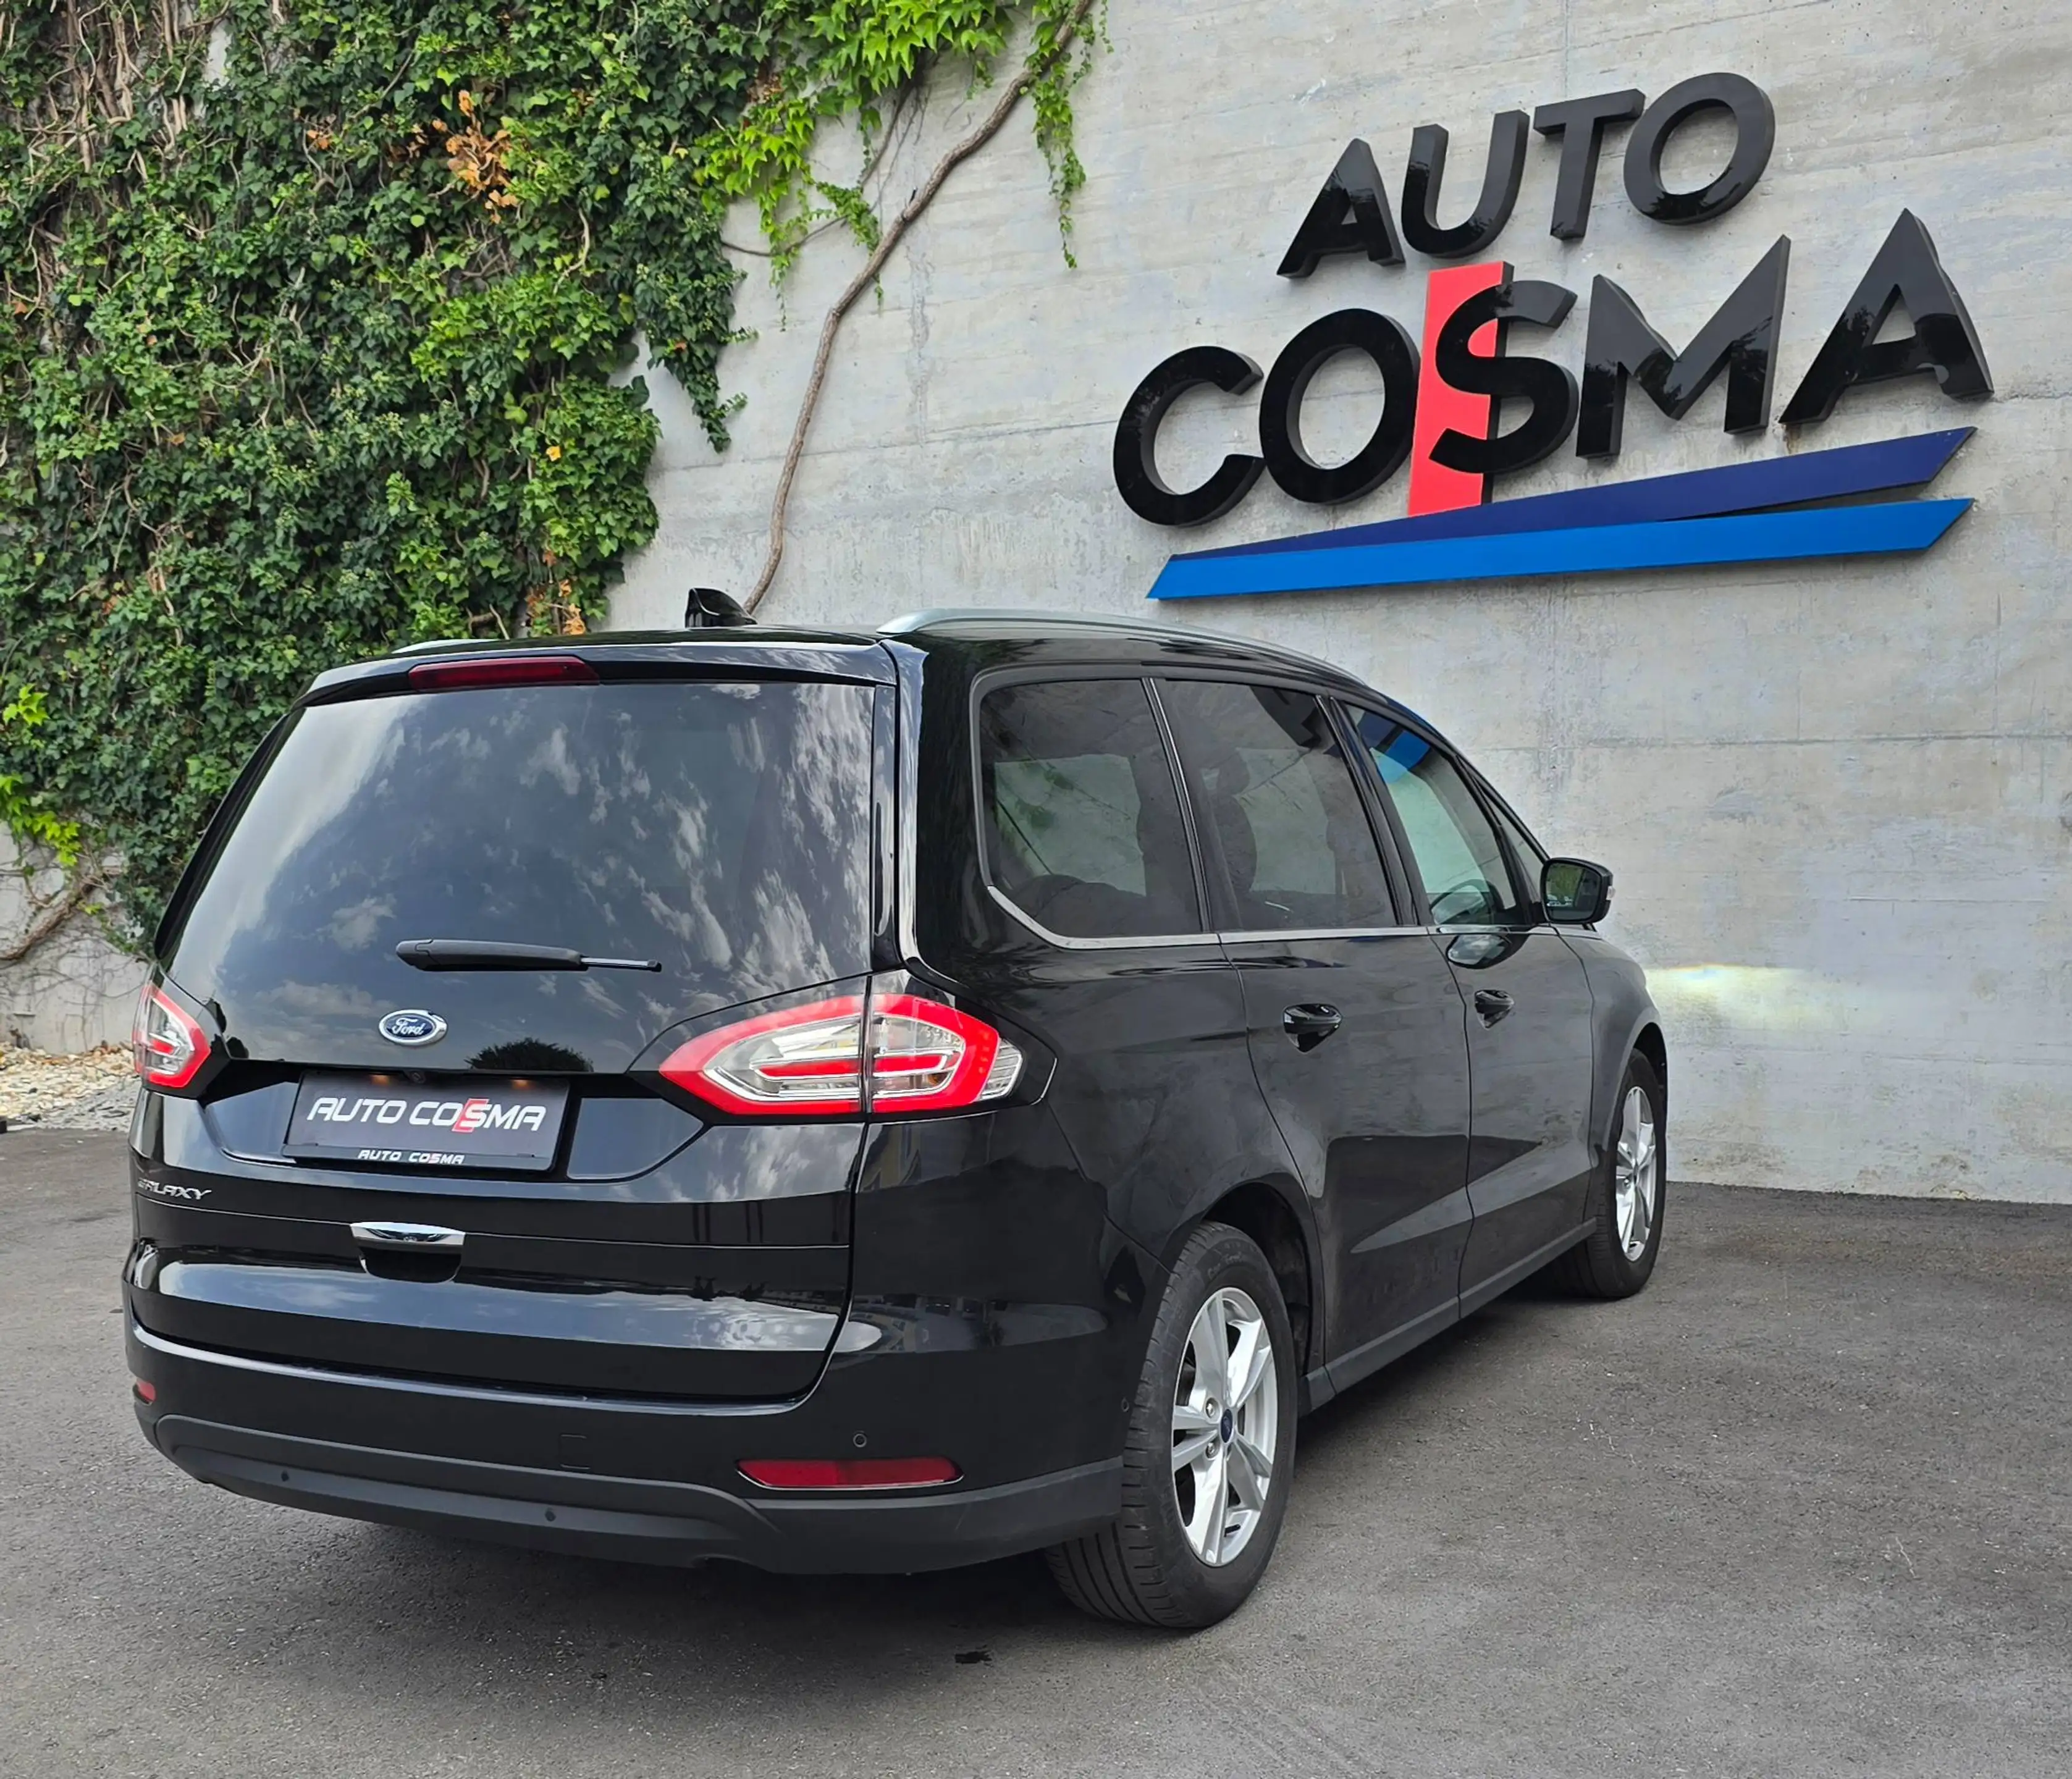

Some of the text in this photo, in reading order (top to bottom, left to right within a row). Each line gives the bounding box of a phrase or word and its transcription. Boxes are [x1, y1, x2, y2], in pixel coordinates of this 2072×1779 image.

[1276, 72, 1776, 279] AUTO
[1113, 208, 1994, 526] COSMA
[392, 1017, 426, 1035] Ford
[306, 1098, 547, 1132] AUTO COSMA
[358, 1149, 465, 1164] AUTO COSMA
